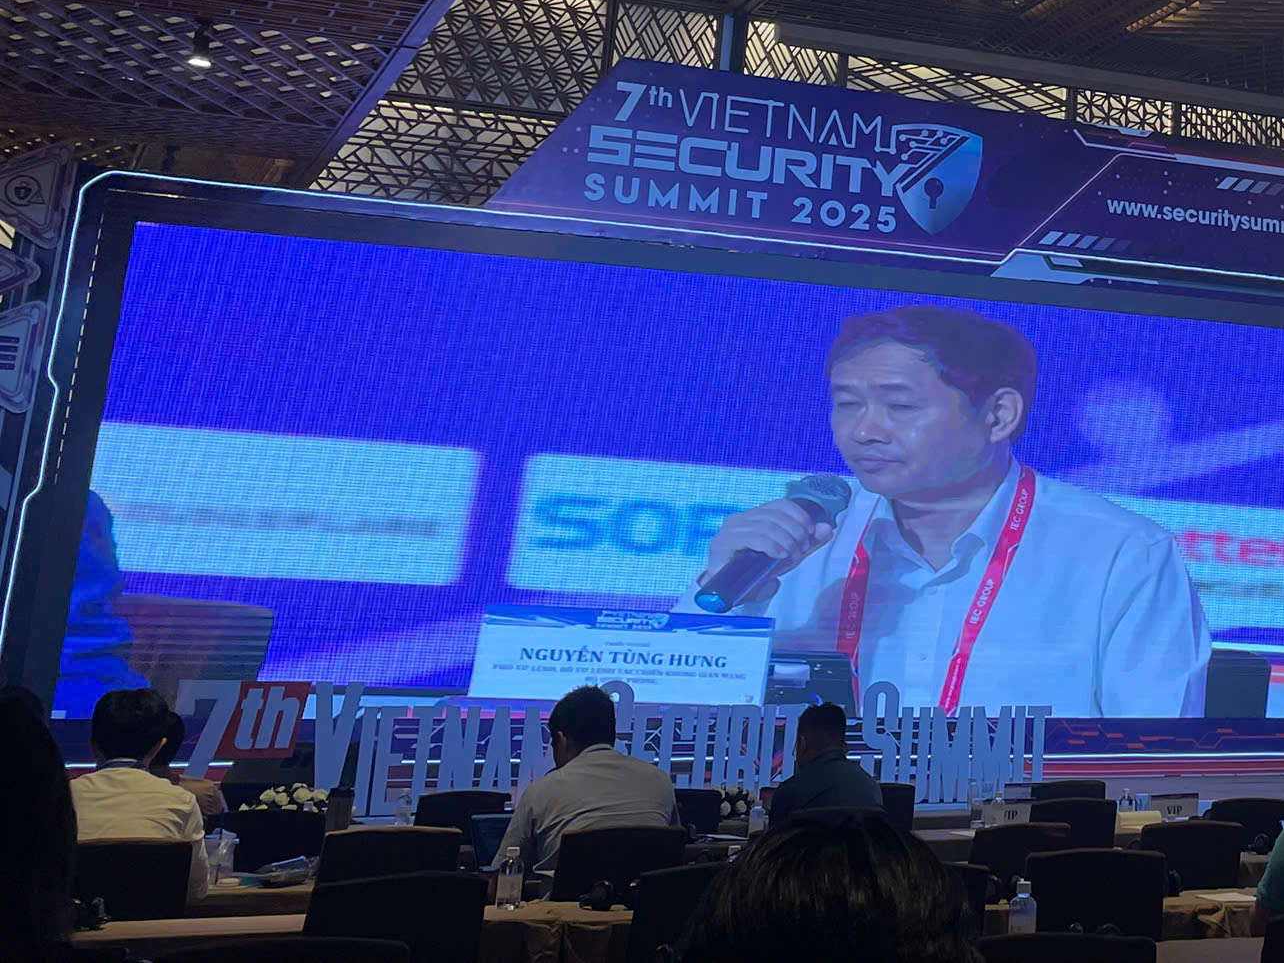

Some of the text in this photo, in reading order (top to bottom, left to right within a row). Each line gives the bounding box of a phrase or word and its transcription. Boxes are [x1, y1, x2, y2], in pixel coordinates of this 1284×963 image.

[615, 81, 897, 155] 7th VIETNAM
[586, 125, 908, 197] SECURITY
[583, 173, 897, 233] SUMMIT 2025
[1016, 488, 1030, 516] GROUP
[977, 578, 996, 608] GROUP
[608, 648, 664, 666] TÙNG
[667, 654, 728, 669] HƯNG
[177, 679, 300, 778] 7th
[600, 680, 845, 789] SECURIT
[862, 681, 1053, 803] SUMMIT
[1167, 804, 1183, 816] VIP
